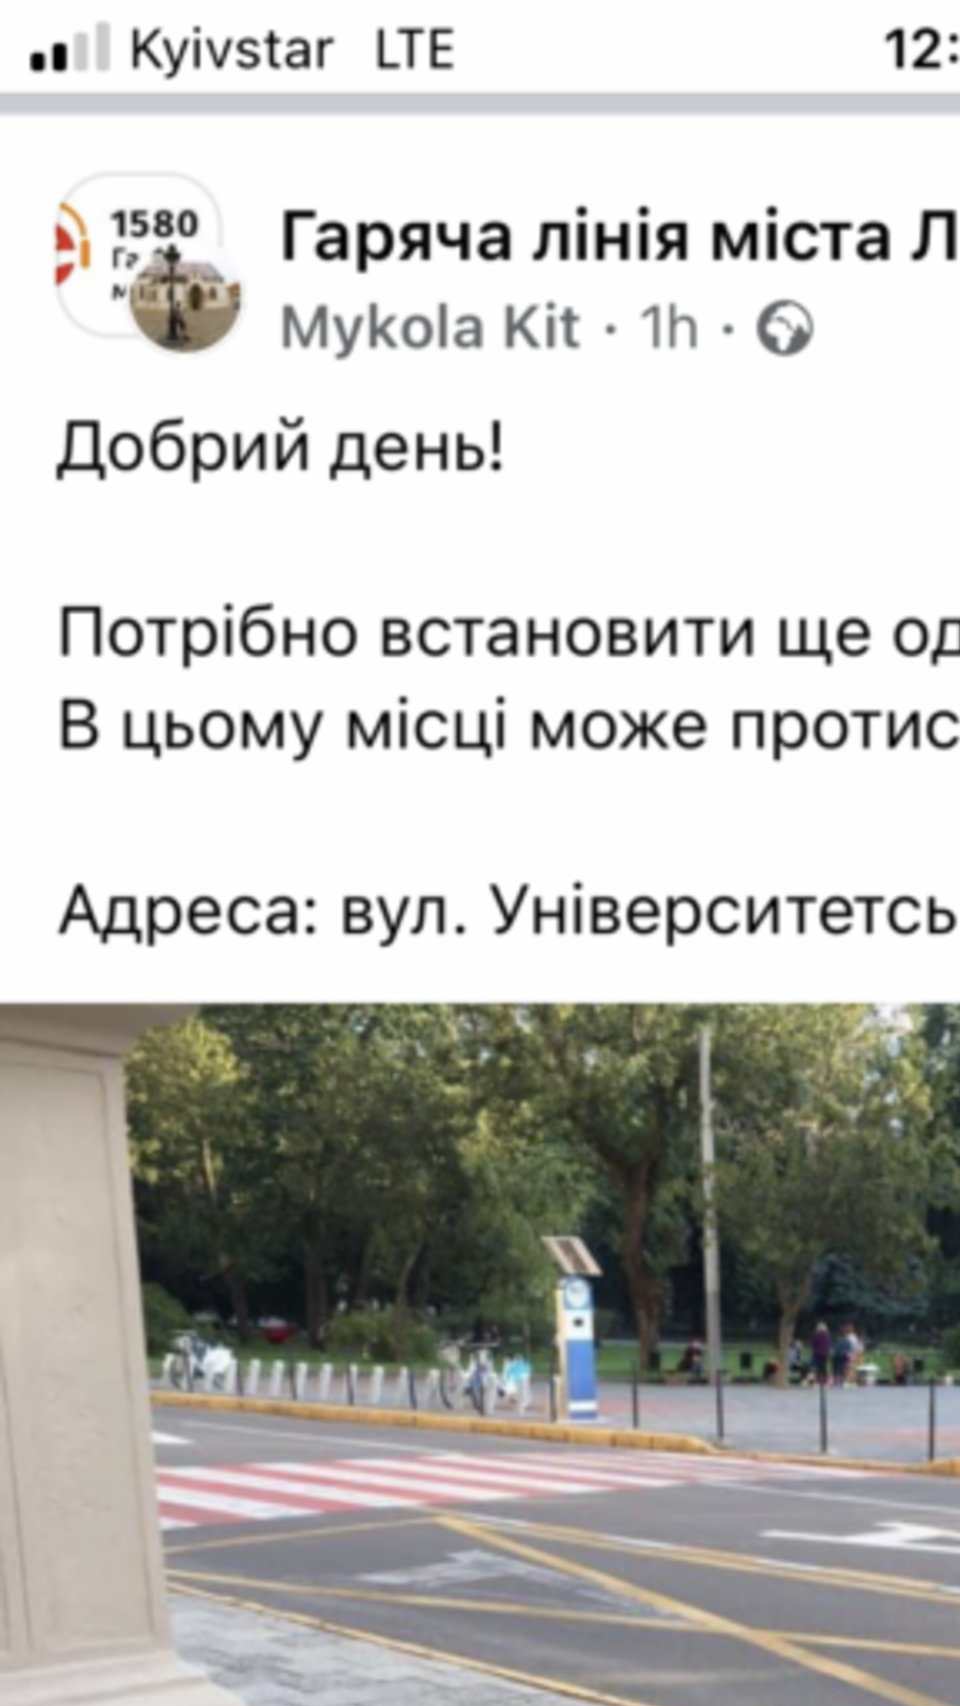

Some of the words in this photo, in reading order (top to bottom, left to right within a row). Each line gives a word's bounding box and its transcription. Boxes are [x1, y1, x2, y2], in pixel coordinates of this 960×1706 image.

[132, 26, 334, 80] Kyivstar
[377, 27, 454, 70] LTE
[110, 208, 199, 239] 1580
[283, 209, 511, 274] Гаряча
[532, 205, 688, 261] лінія
[712, 205, 890, 262] міста
[283, 303, 483, 358] Mykola
[505, 301, 580, 348] Kit
[642, 303, 697, 348] 1h
[56, 416, 308, 484] Добрий
[329, 419, 502, 481] день!
[60, 603, 358, 669] Потрібно
[382, 616, 754, 657] встановити
[779, 616, 871, 667] ще
[60, 697, 99, 750] В
[123, 709, 324, 762] цьому
[347, 696, 505, 759] місці
[531, 709, 707, 750] може
[58, 883, 316, 947] Адреса:
[343, 896, 466, 948] вул.
